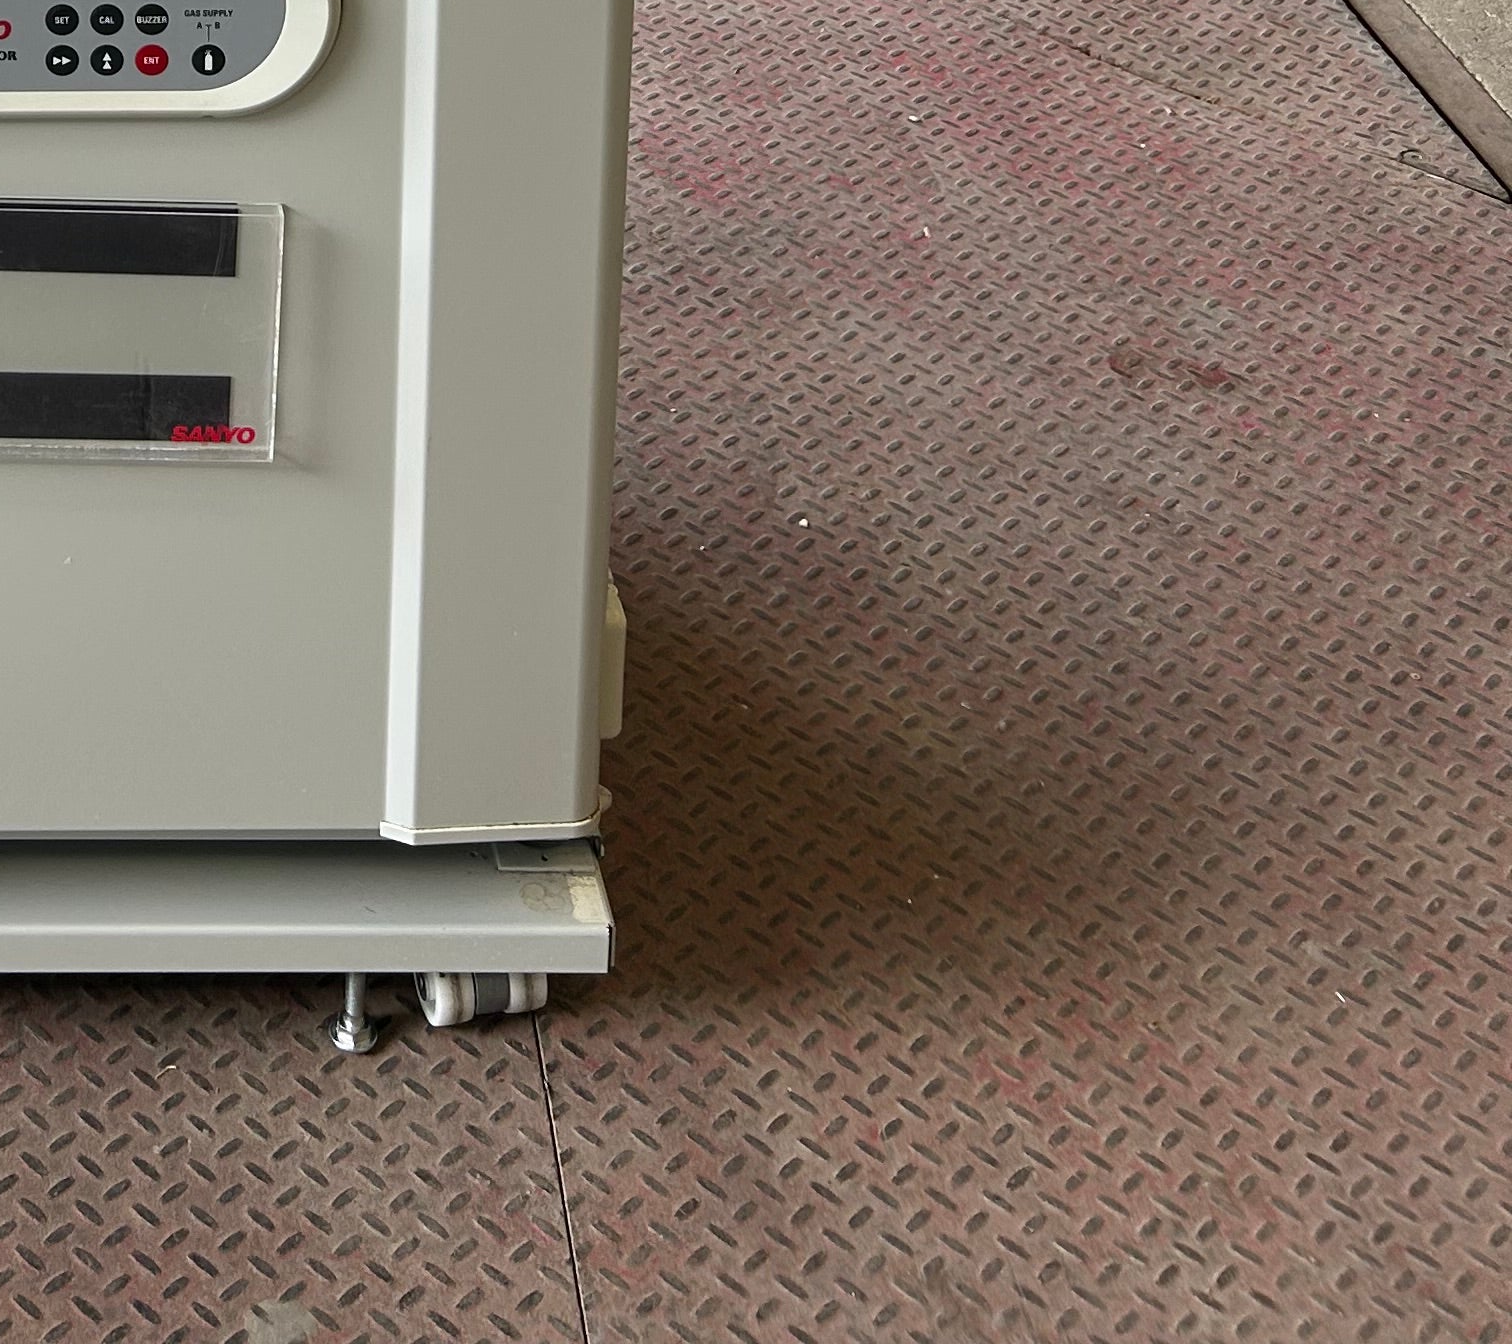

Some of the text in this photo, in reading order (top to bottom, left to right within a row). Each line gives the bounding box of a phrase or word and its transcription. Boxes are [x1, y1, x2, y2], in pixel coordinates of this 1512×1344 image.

[184, 9, 233, 18] GAS SUPPLY
[54, 15, 168, 25] SET CAL BUZZER
[196, 21, 220, 30] A B
[144, 56, 160, 65] ENT
[169, 425, 256, 445] SANYO
